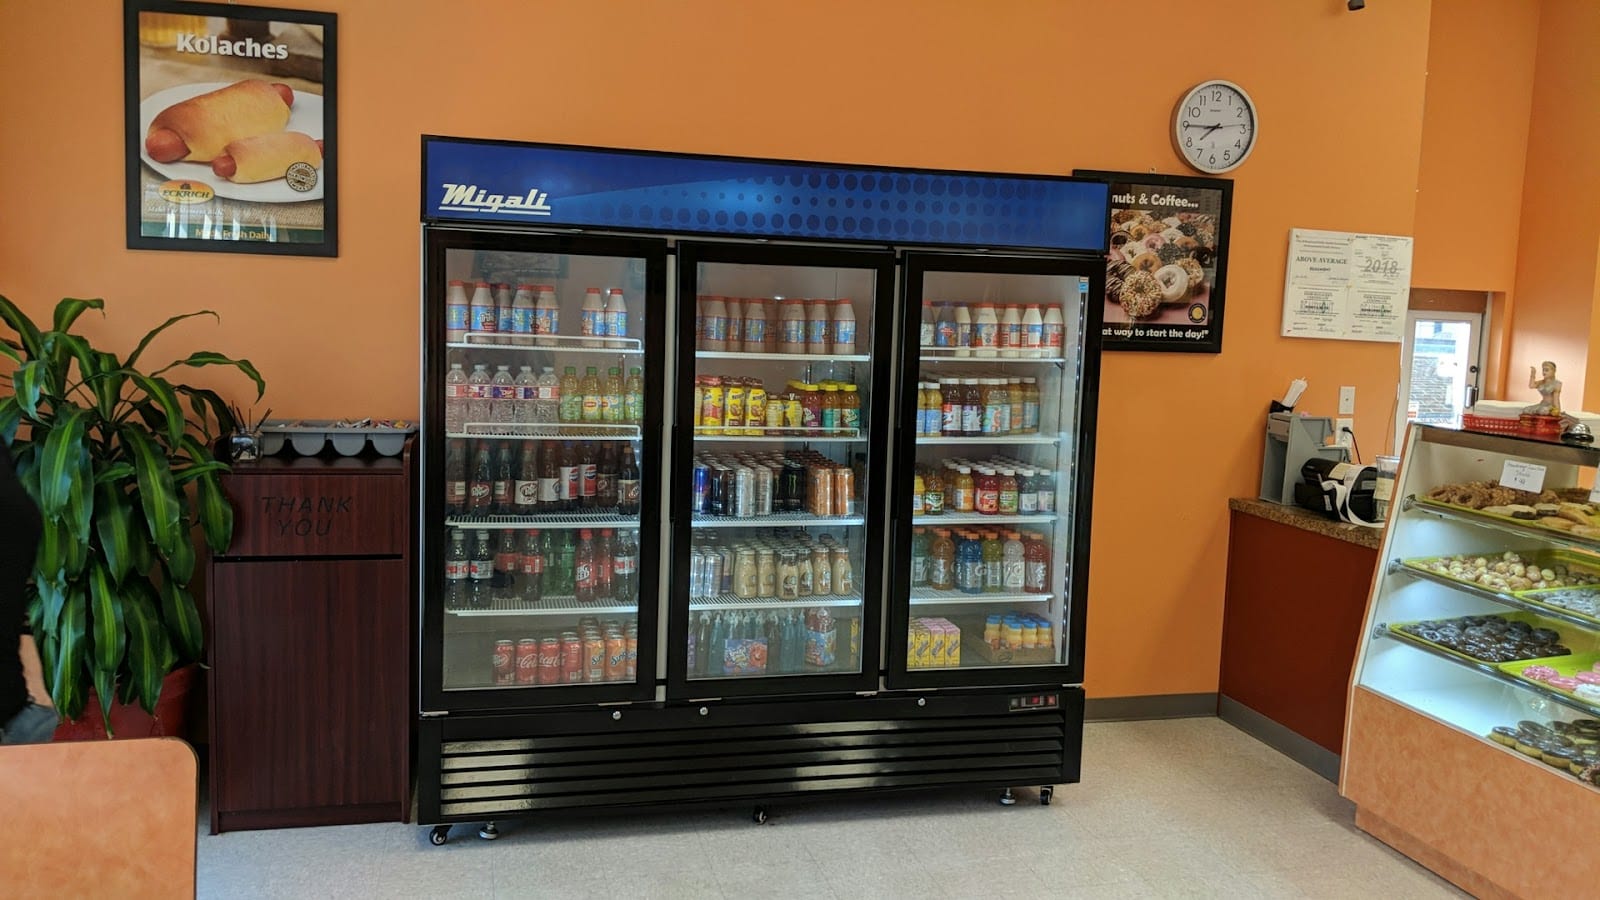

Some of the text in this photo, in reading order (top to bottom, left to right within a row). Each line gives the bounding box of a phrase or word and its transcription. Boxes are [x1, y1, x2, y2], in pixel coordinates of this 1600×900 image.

[176, 32, 289, 60] Kolaches
[1200, 95, 1207, 106] 11
[1211, 90, 1222, 102] 12
[1188, 106, 1201, 118] 10
[1236, 107, 1243, 118] 2
[1182, 120, 1190, 131] 9
[1239, 123, 1247, 135] 3
[1185, 136, 1193, 148] 8
[1234, 138, 1241, 149] 4
[1196, 148, 1203, 159] 7
[1208, 153, 1216, 165] 6
[1223, 150, 1231, 161] 5
[162, 189, 210, 199] ECKRICH
[440, 183, 551, 214] Migali
[1138, 192, 1149, 205] &
[1150, 193, 1199, 209] Coffee...
[1296, 255, 1347, 265] ABOVE AVERAGE
[1365, 258, 1398, 274] 2018
[1113, 328, 1134, 339] way
[1134, 328, 1145, 337] to
[1146, 328, 1168, 338] start
[1169, 329, 1184, 339] the
[261, 496, 353, 513] THANK
[276, 518, 333, 537] YOU
